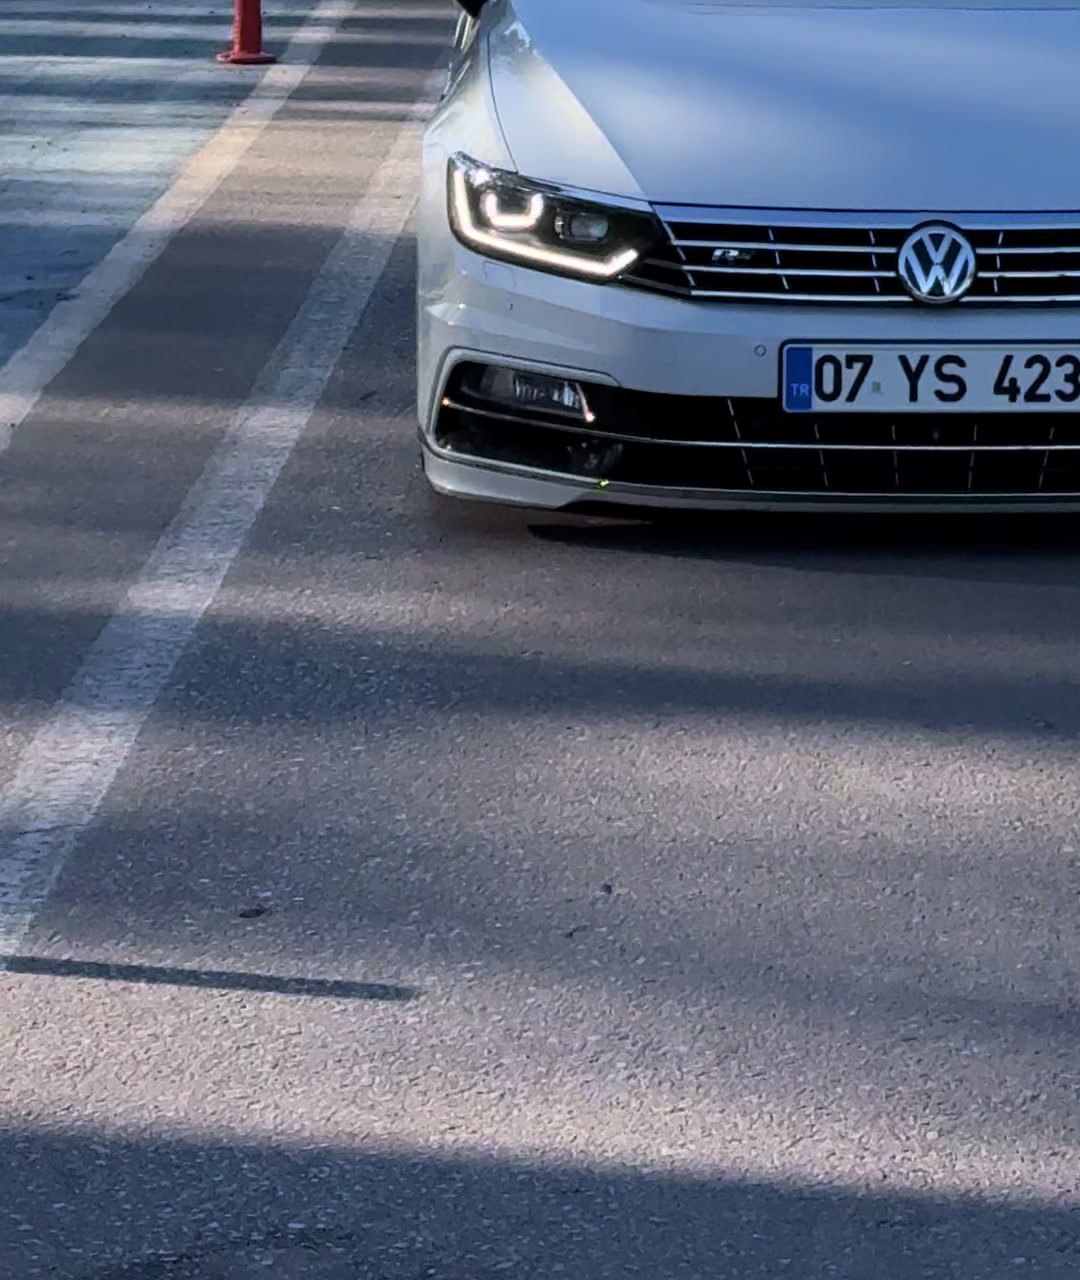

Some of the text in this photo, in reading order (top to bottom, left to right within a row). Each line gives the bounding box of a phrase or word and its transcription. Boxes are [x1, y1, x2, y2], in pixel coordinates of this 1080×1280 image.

[790, 383, 810, 397] TR
[814, 354, 873, 402] 07
[898, 354, 967, 402] YS
